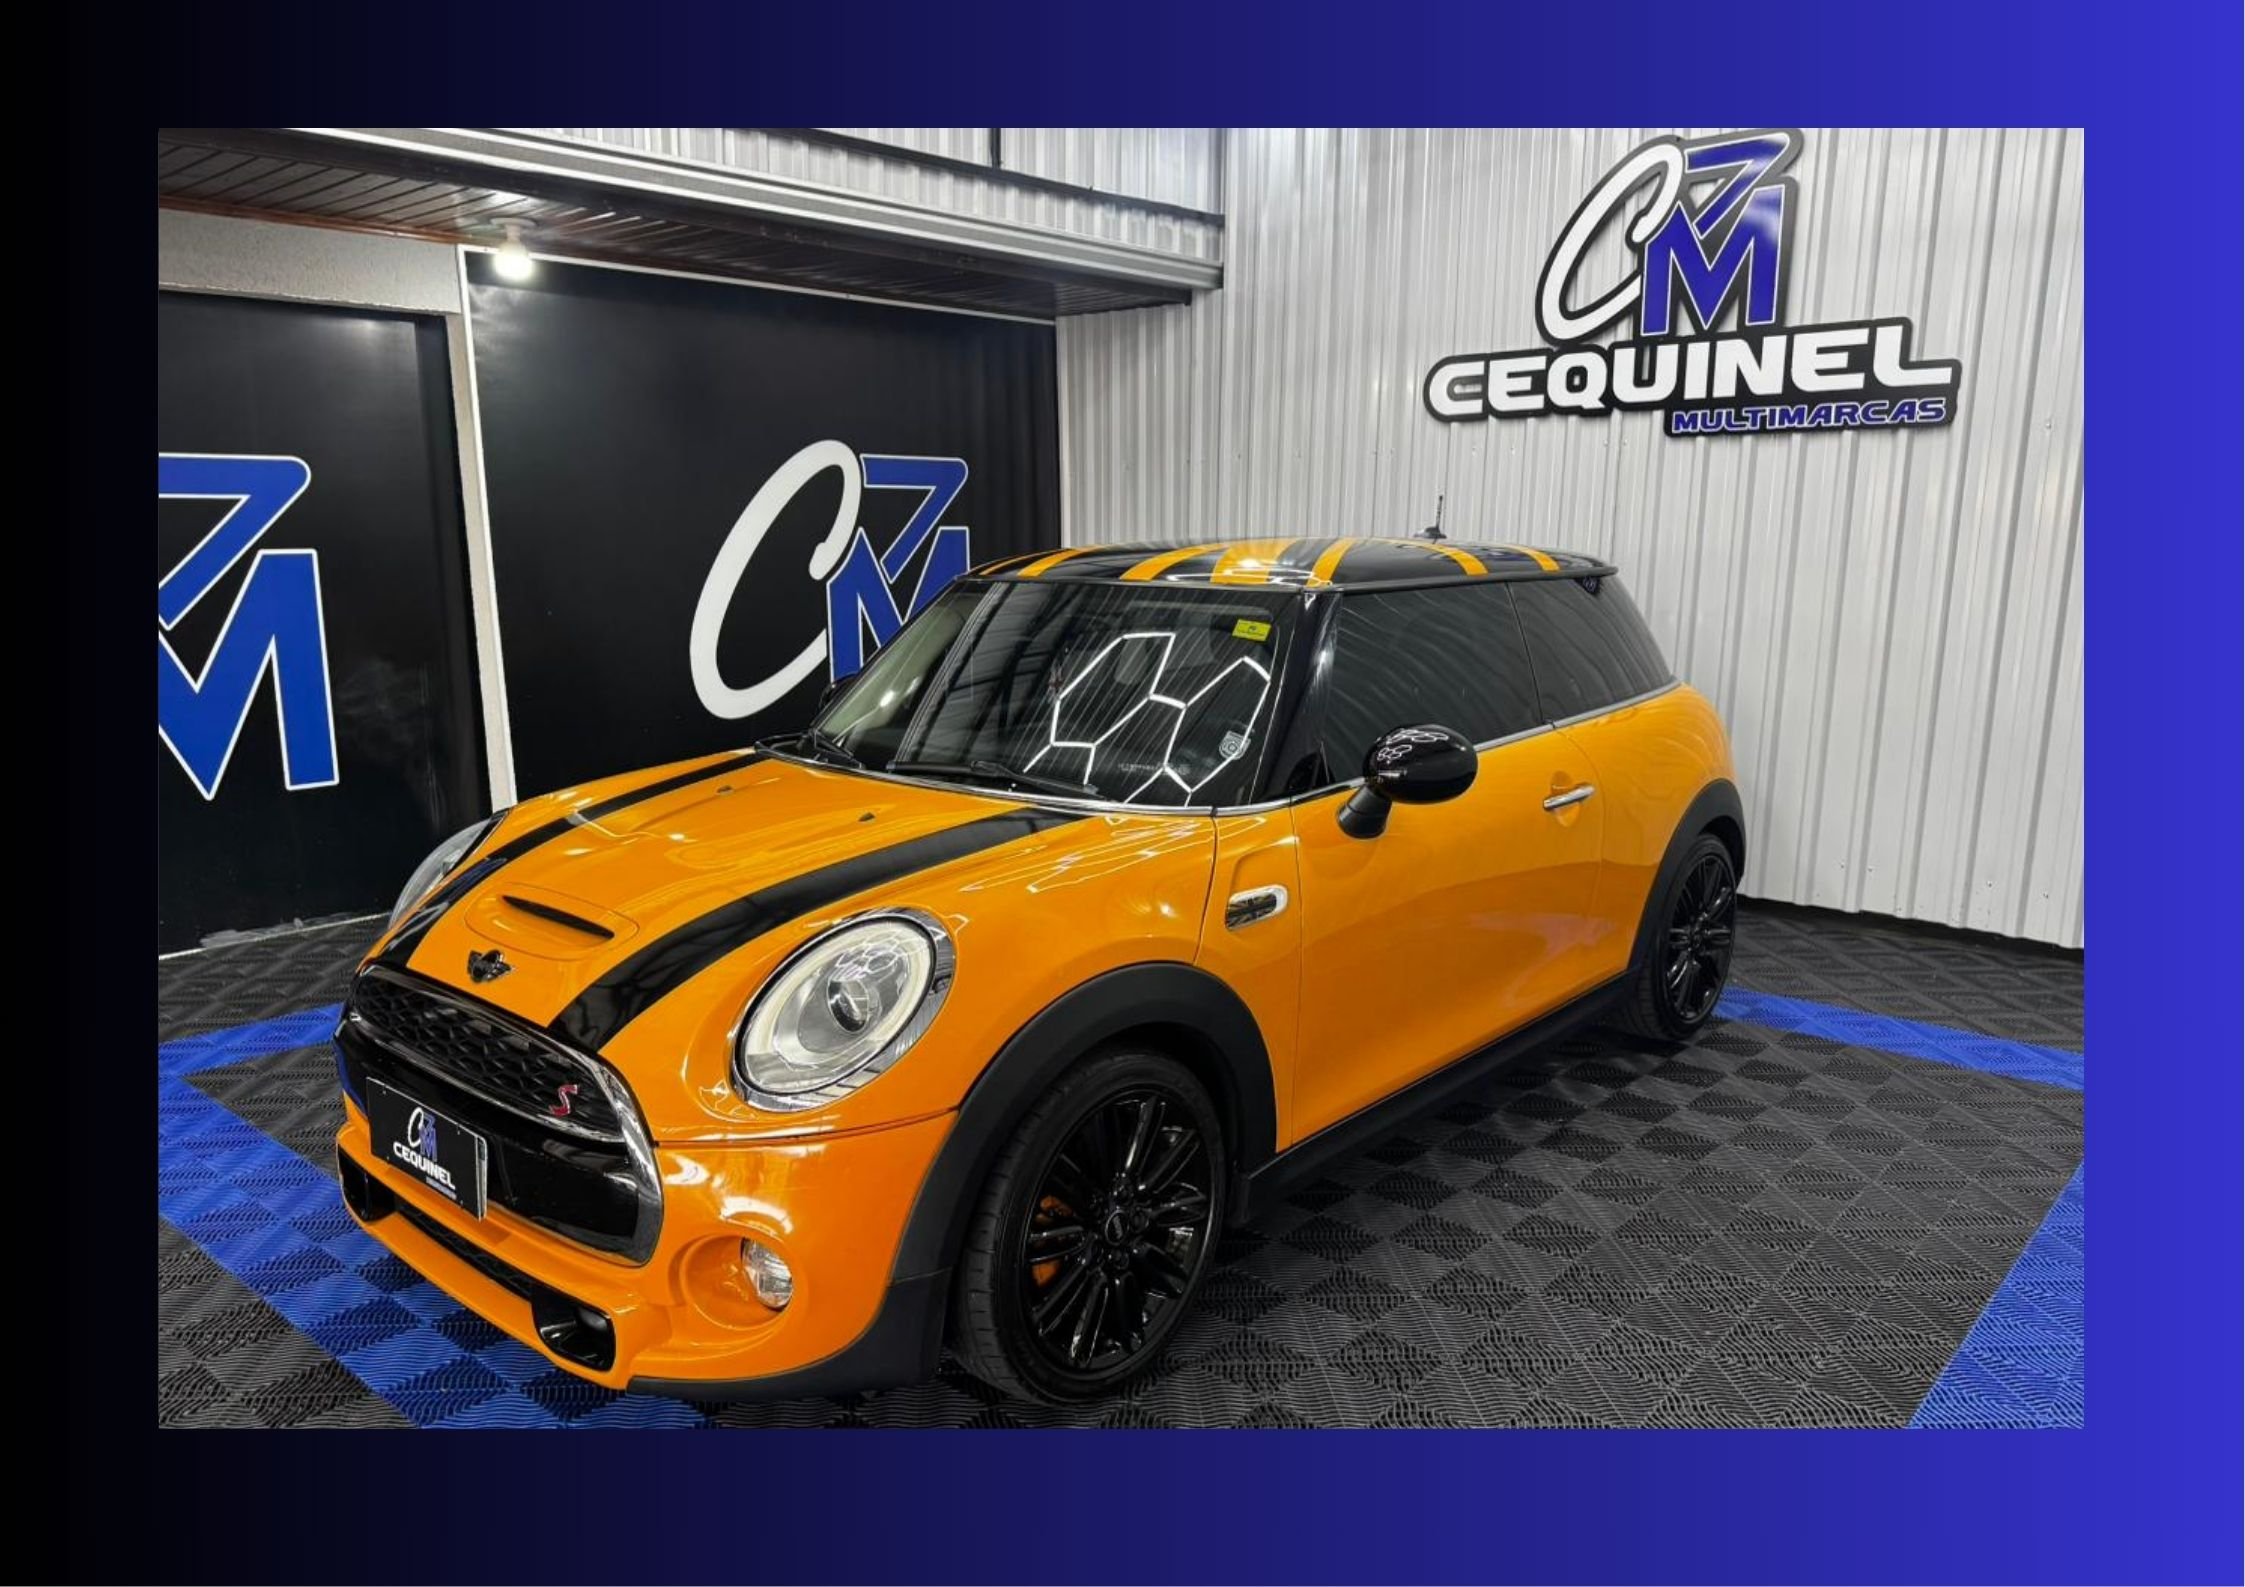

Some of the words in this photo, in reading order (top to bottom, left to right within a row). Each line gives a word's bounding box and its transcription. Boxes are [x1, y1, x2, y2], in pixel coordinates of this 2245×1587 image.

[1429, 325, 1953, 417] CEQUINEL
[1671, 398, 1946, 434] MULTIMARCAS
[393, 1141, 456, 1190] CEQUINEL
